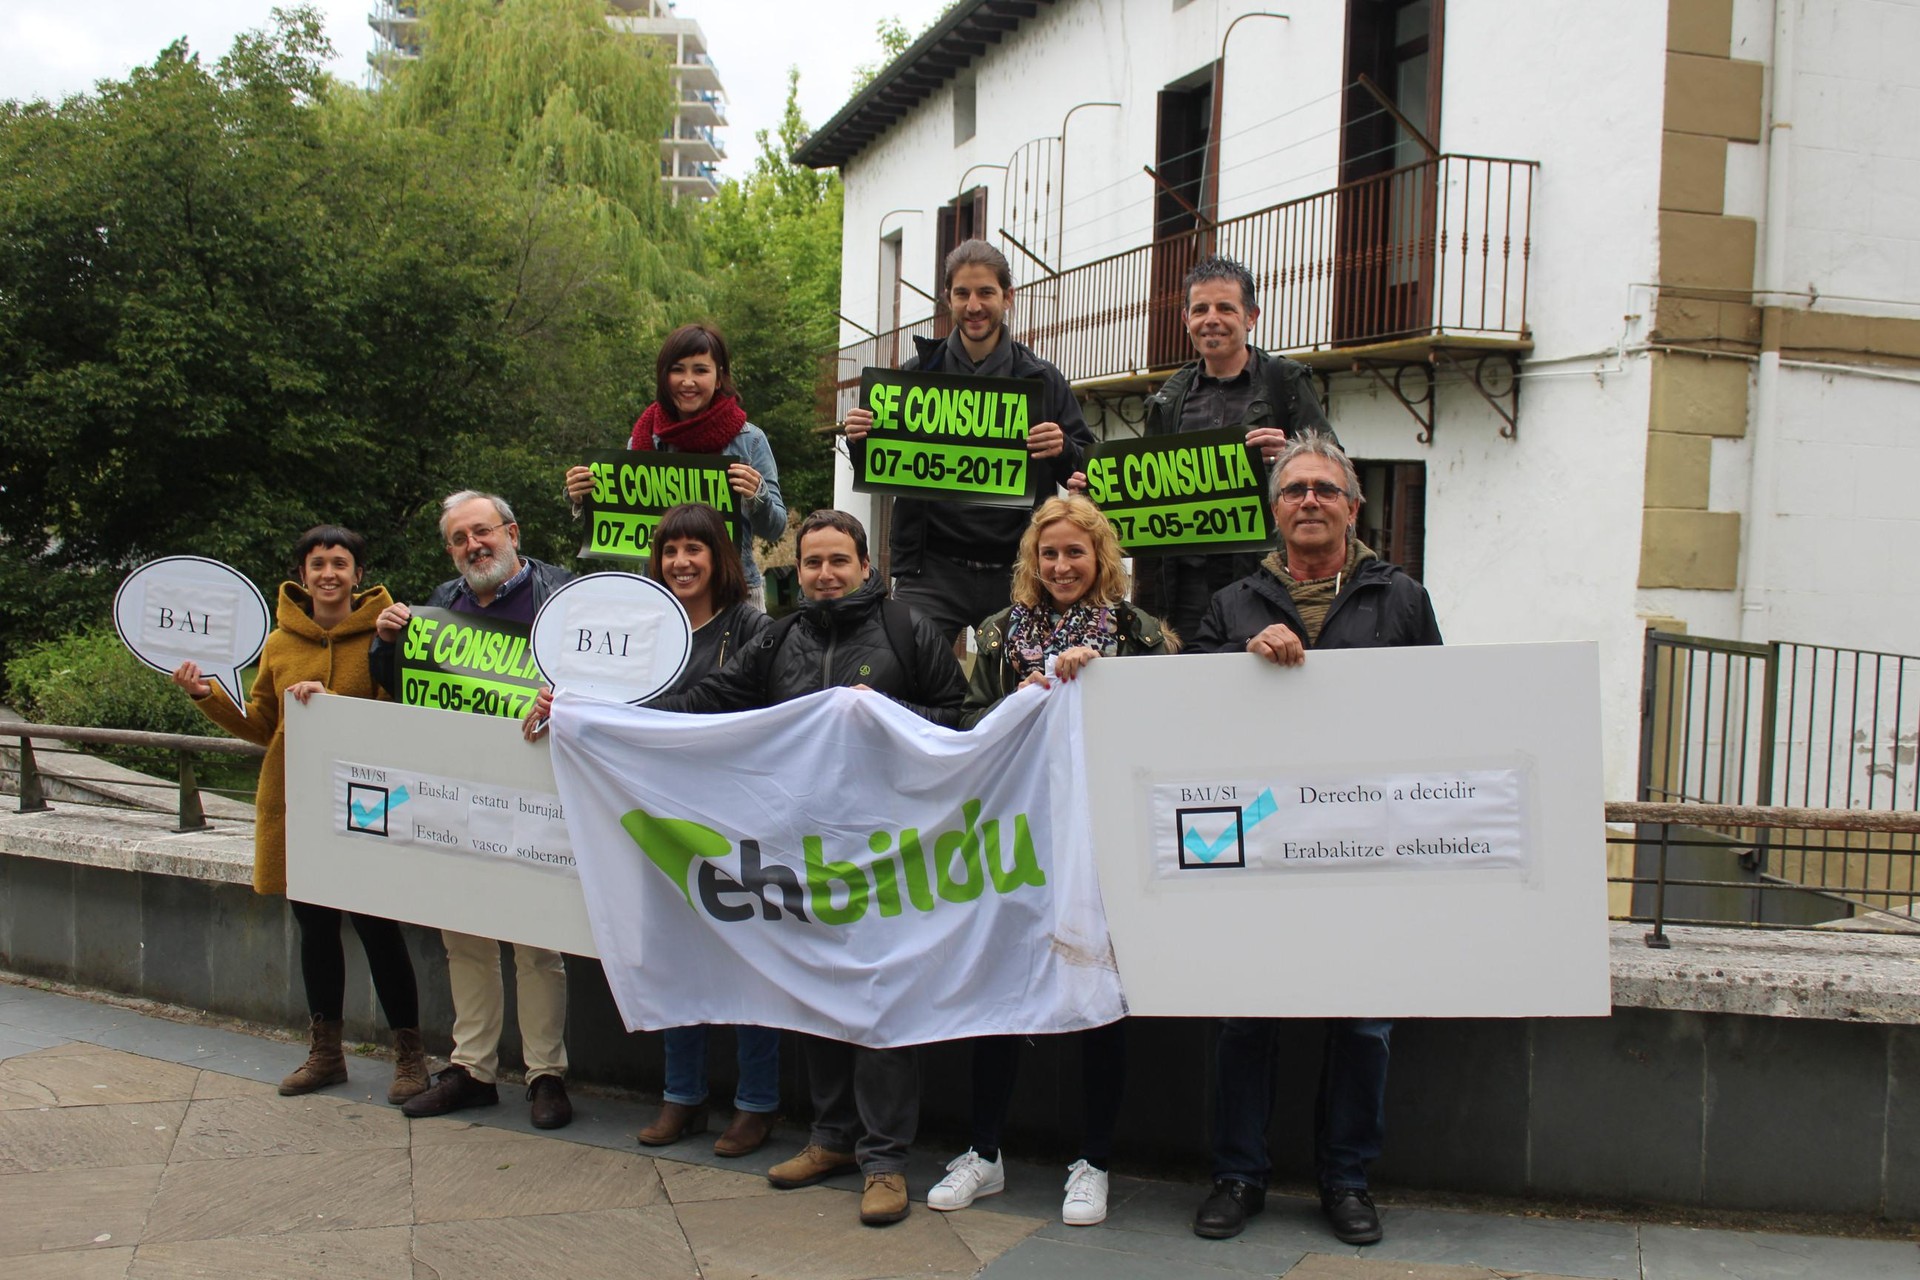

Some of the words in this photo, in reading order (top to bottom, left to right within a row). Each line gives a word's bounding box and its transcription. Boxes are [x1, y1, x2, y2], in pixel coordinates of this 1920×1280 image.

[869, 382, 902, 430] SE
[904, 386, 1030, 440] CONSULTA
[869, 447, 1023, 488] 07-05-2017
[1087, 456, 1123, 504] SE
[1123, 443, 1258, 501] CONSULTA
[588, 462, 619, 504] SE
[619, 463, 733, 512] CONSULTA
[157, 607, 211, 636] BAI
[403, 616, 439, 661] SE
[575, 628, 632, 657] BAI
[405, 678, 531, 719] 07-05-2017
[351, 766, 387, 783] BAI/SI
[418, 781, 460, 802] Euskal
[471, 792, 509, 810] estatu
[1180, 785, 1238, 803] BAI/SI
[1299, 785, 1382, 805] Derecho
[1393, 788, 1404, 801] a
[1409, 781, 1477, 801] decidir
[416, 824, 458, 845] Estado
[472, 837, 508, 854] vasco
[516, 845, 577, 867] soberano
[1282, 840, 1385, 860] Erabakitze
[1395, 837, 1492, 856] eskubidea
